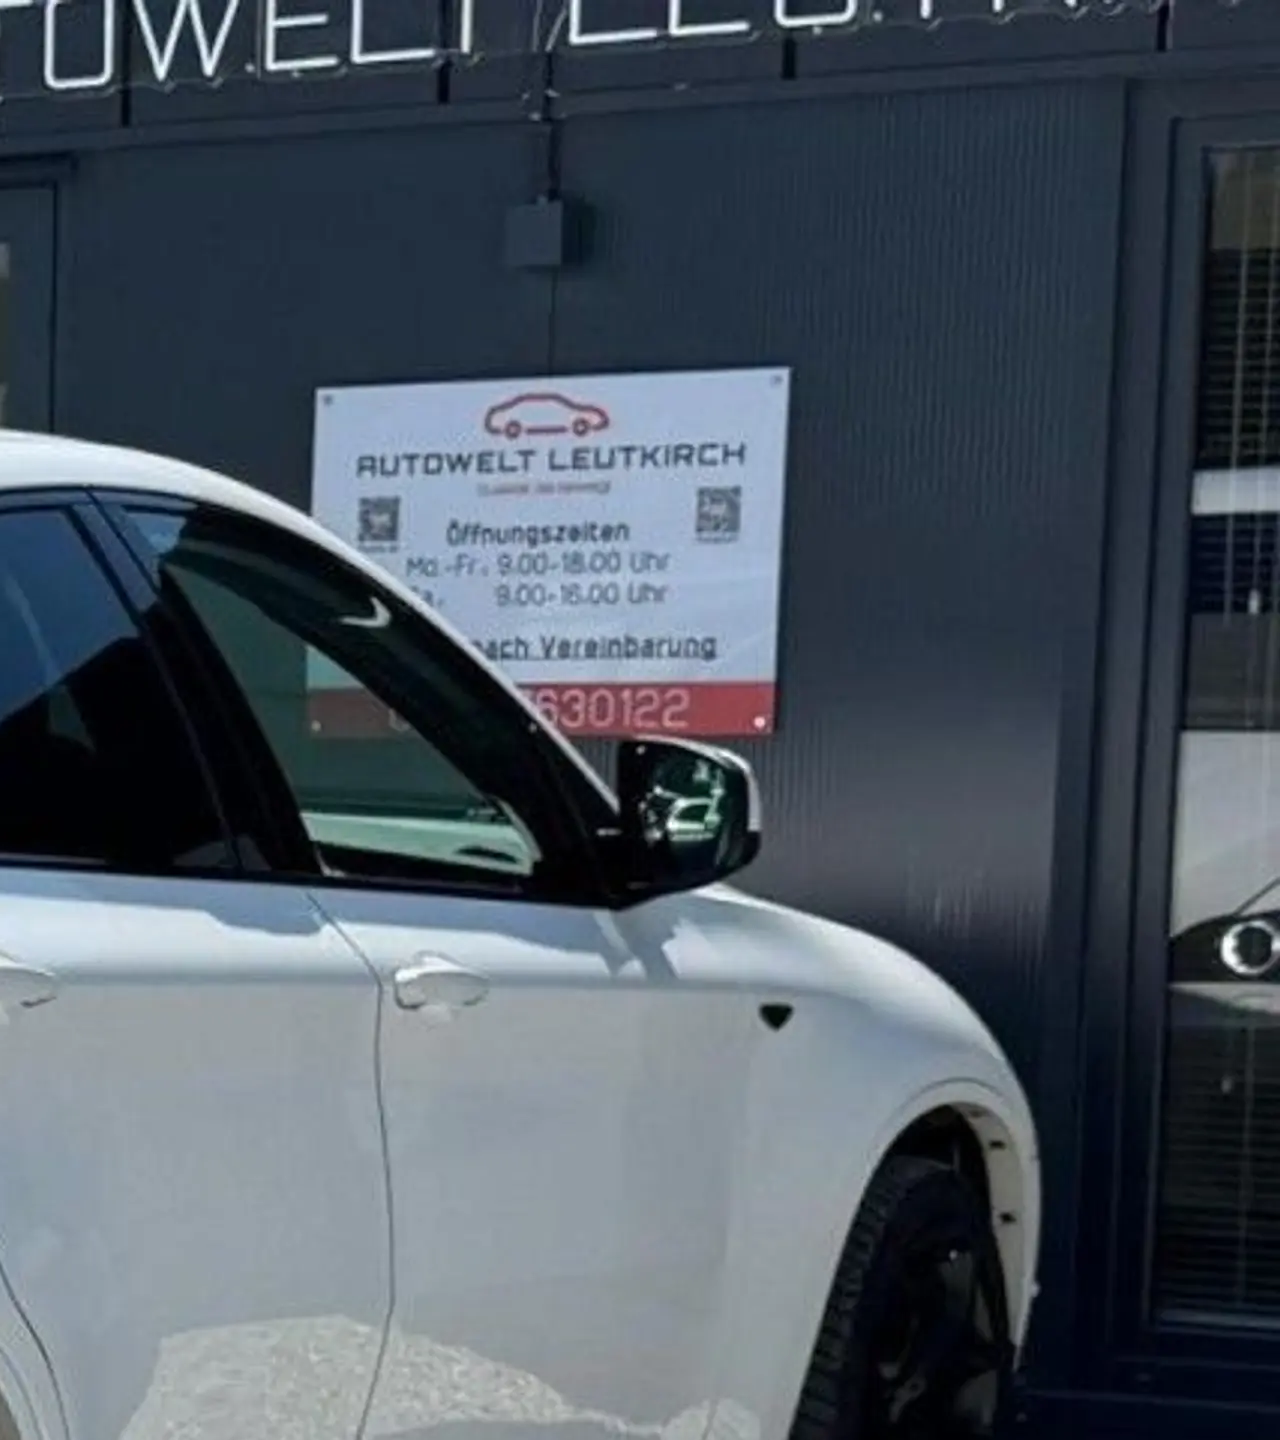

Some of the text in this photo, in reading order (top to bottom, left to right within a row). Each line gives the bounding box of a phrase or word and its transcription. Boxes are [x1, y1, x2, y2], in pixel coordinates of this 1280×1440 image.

[357, 442, 747, 478] AUTOWELT LEUTKIRCH
[446, 518, 629, 548] Öffnungszeiten
[629, 552, 671, 574] Uhr
[627, 582, 669, 604] Uhr
[541, 633, 718, 660] Vereinbarung
